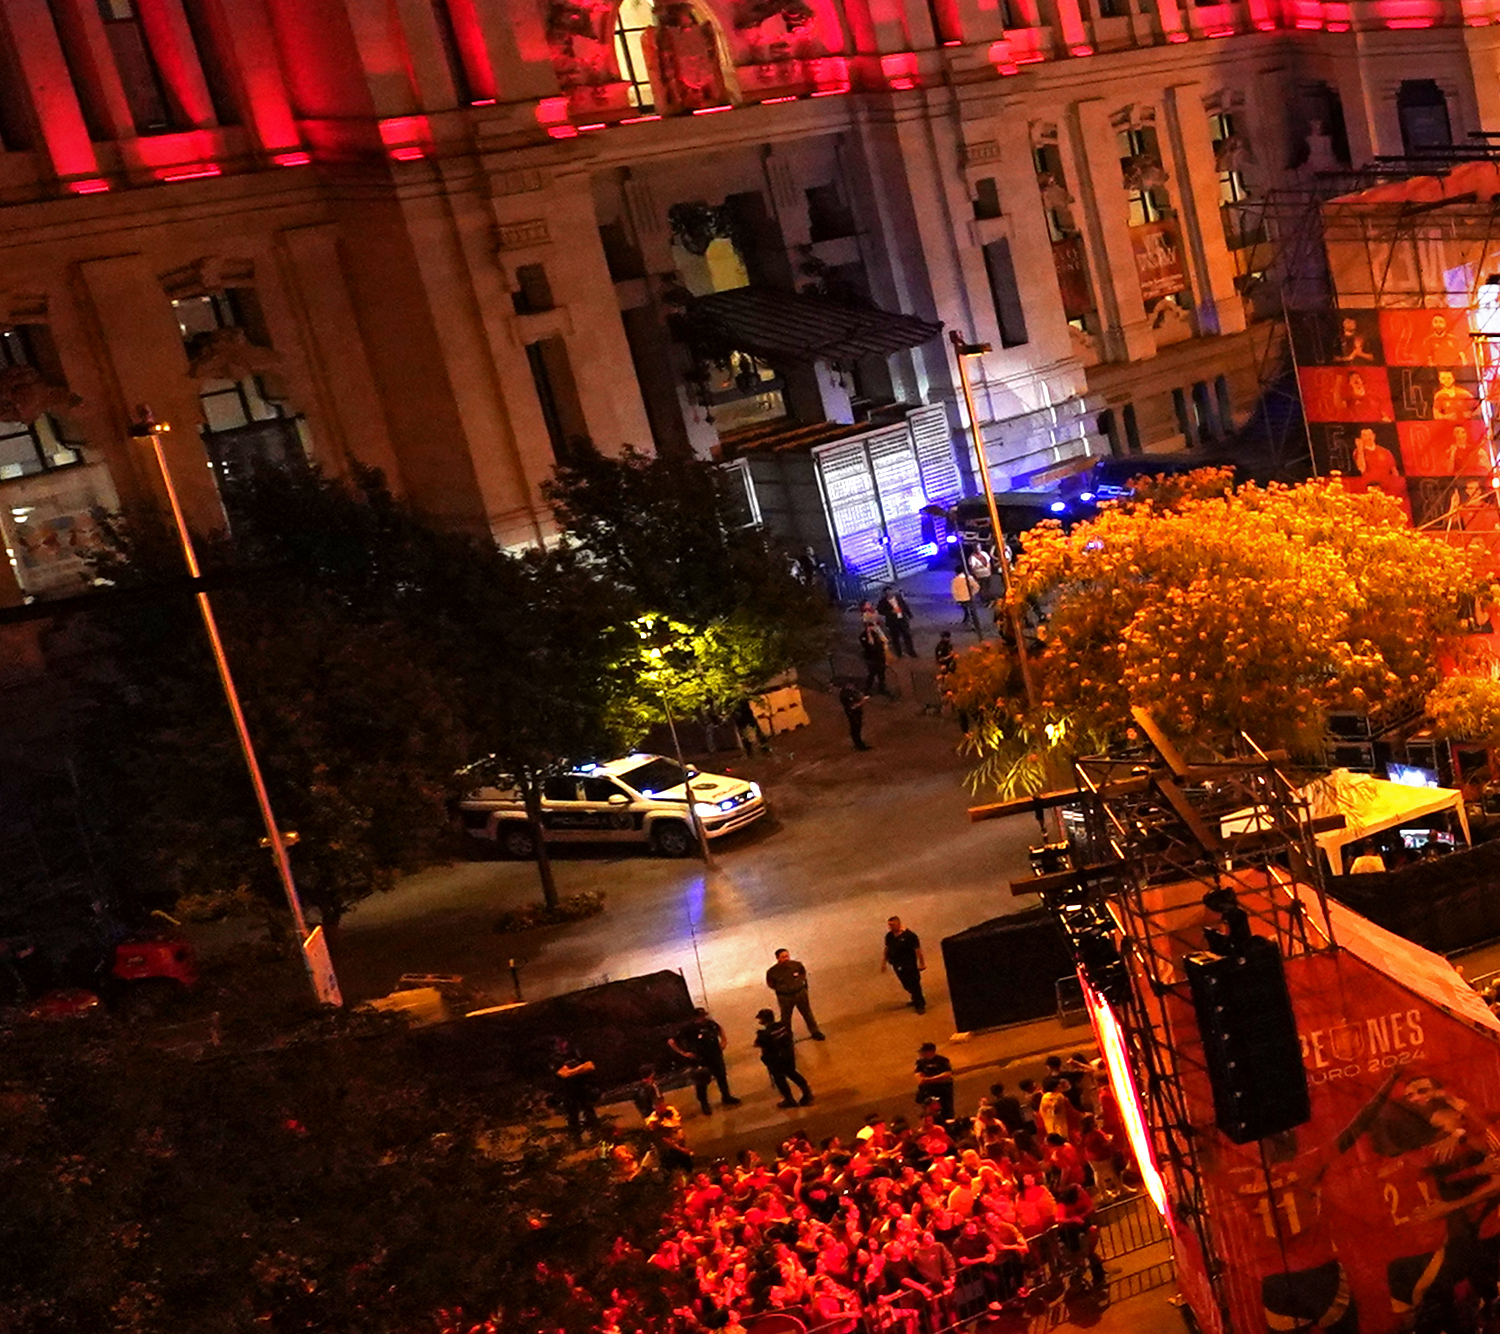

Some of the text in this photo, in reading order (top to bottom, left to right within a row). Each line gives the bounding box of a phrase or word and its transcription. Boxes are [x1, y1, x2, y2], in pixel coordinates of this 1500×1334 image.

[1402, 370, 1428, 419] 4
[1366, 1009, 1424, 1055] NES
[1308, 1051, 1426, 1085] URO 2024
